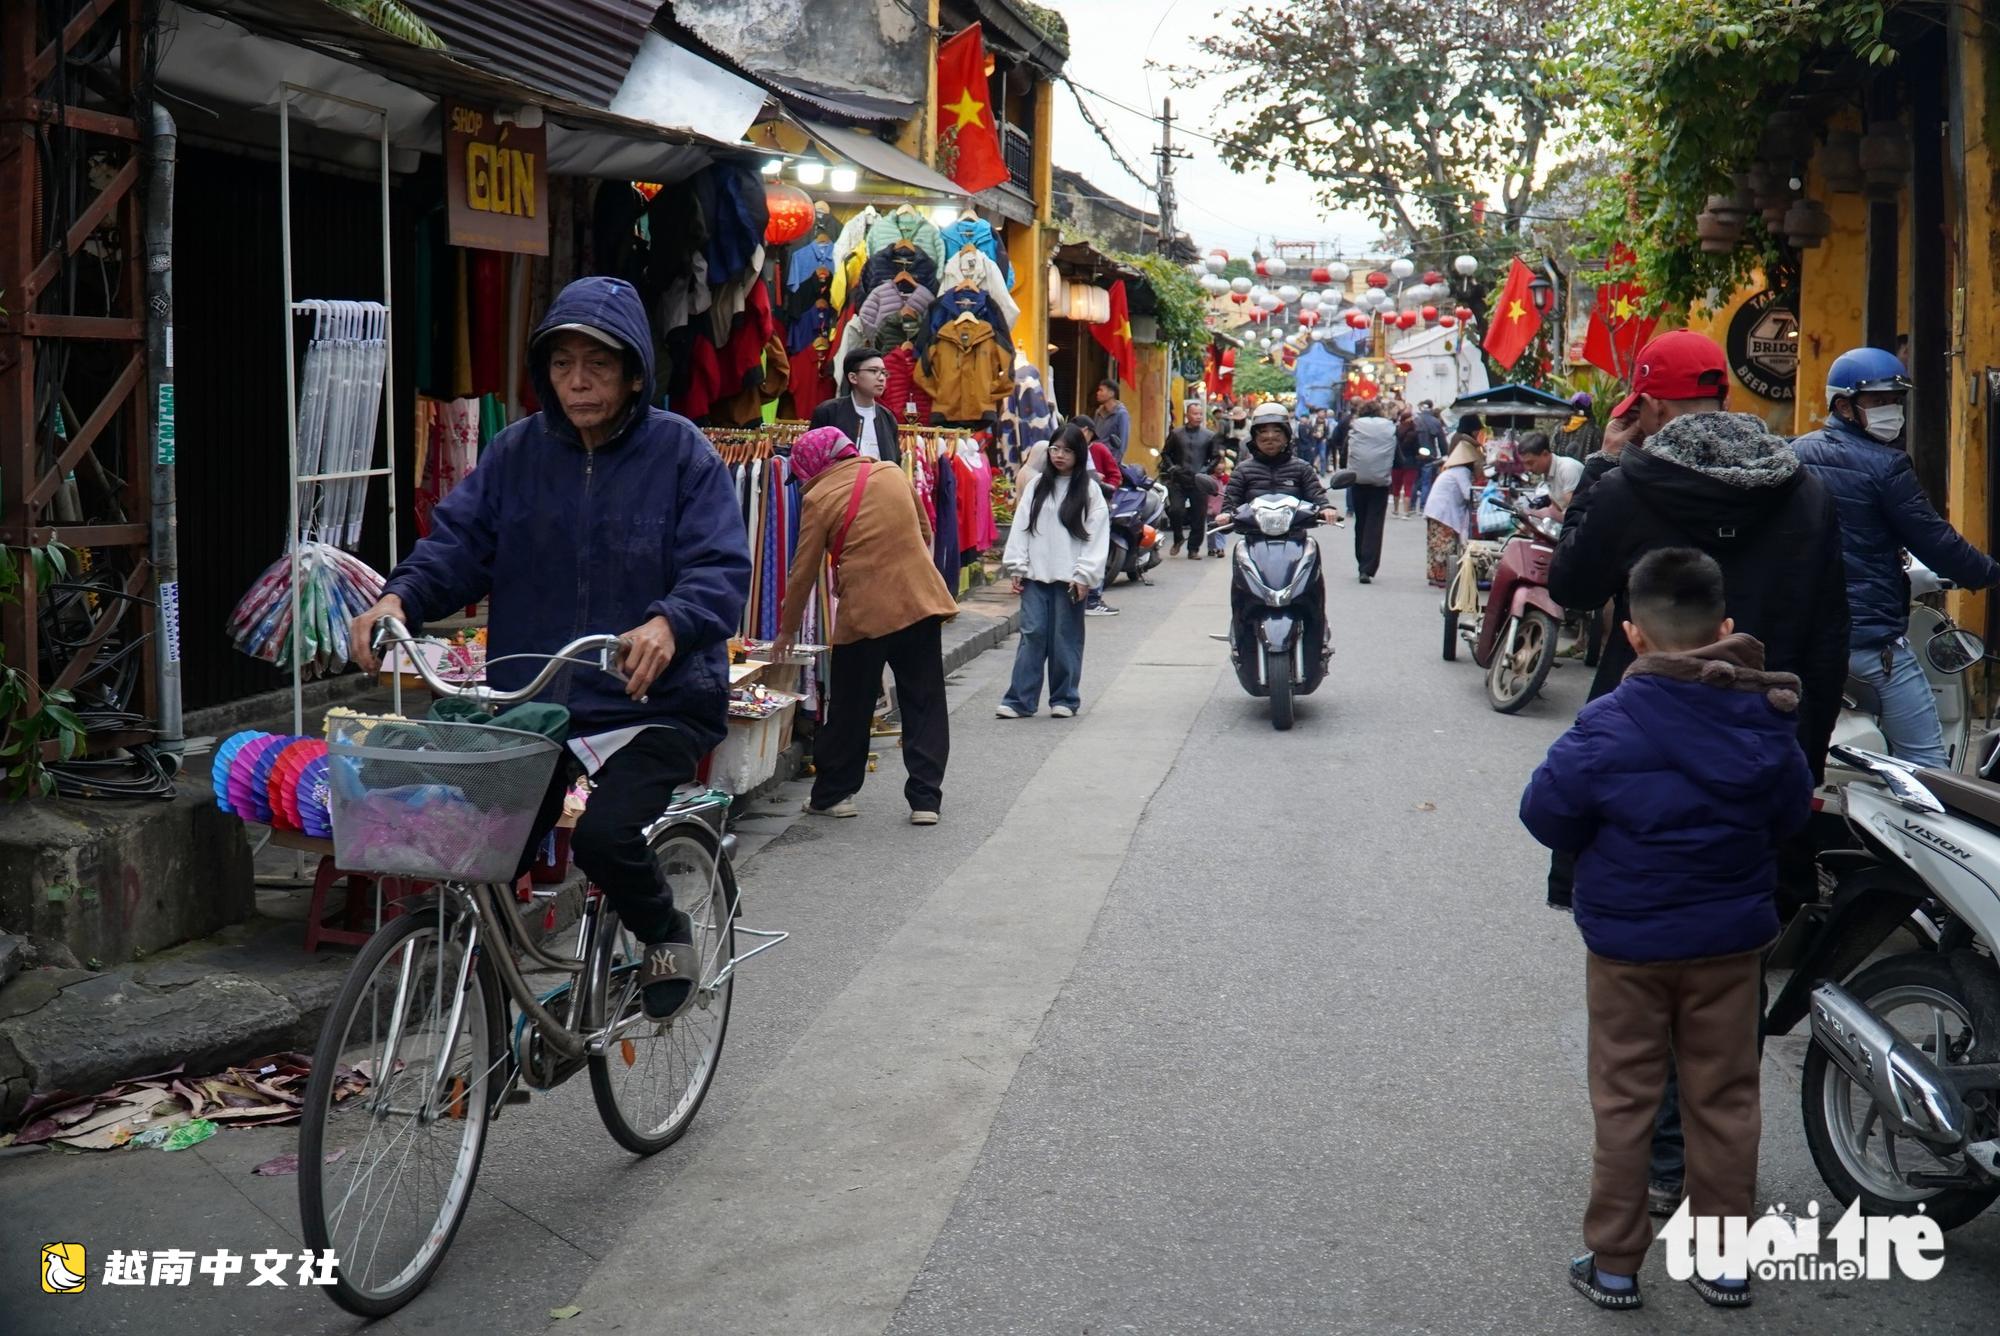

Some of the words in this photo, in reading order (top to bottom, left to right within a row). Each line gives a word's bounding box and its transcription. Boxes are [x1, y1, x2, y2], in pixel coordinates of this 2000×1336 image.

[452, 107, 484, 136] SHOP
[1737, 364, 1769, 395] BEER
[1904, 819, 1973, 860] VISION
[650, 949, 678, 976] NY
